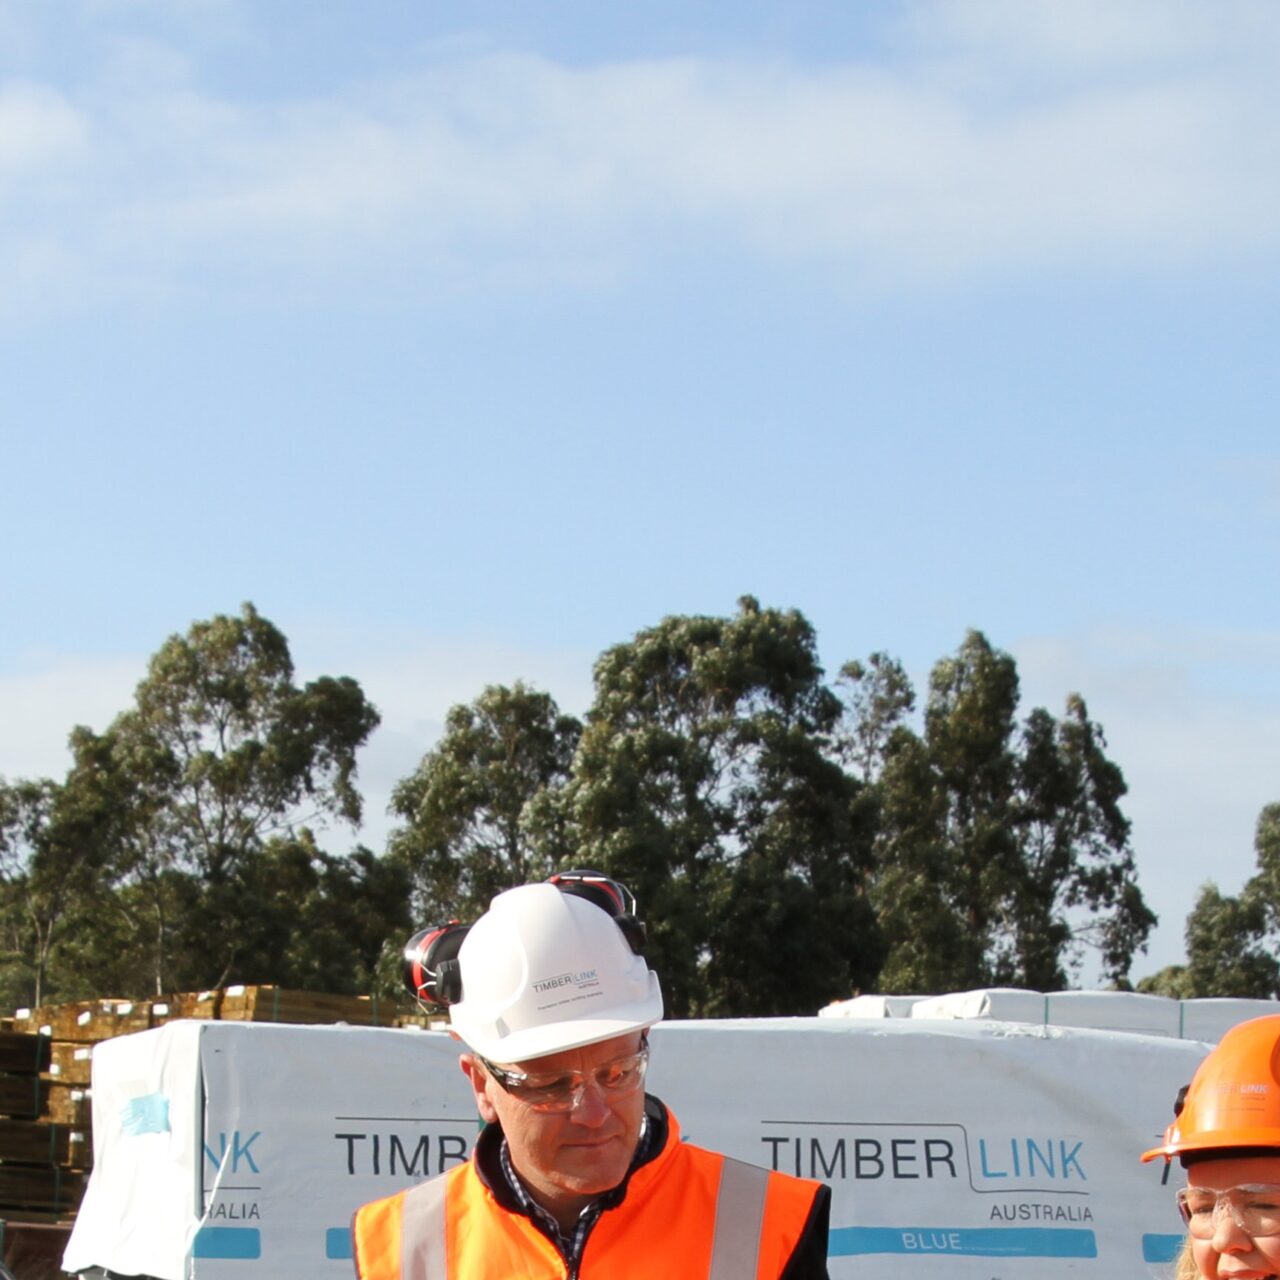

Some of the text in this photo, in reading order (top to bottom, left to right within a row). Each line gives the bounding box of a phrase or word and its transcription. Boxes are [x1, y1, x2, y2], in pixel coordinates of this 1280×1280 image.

[532, 976, 573, 993] TIMBER
[574, 969, 598, 982] LINK
[761, 1137, 1087, 1181] TIMBER LINK
[989, 1203, 1094, 1222] AUSTRALIA
[901, 1232, 963, 1250] BLUE
